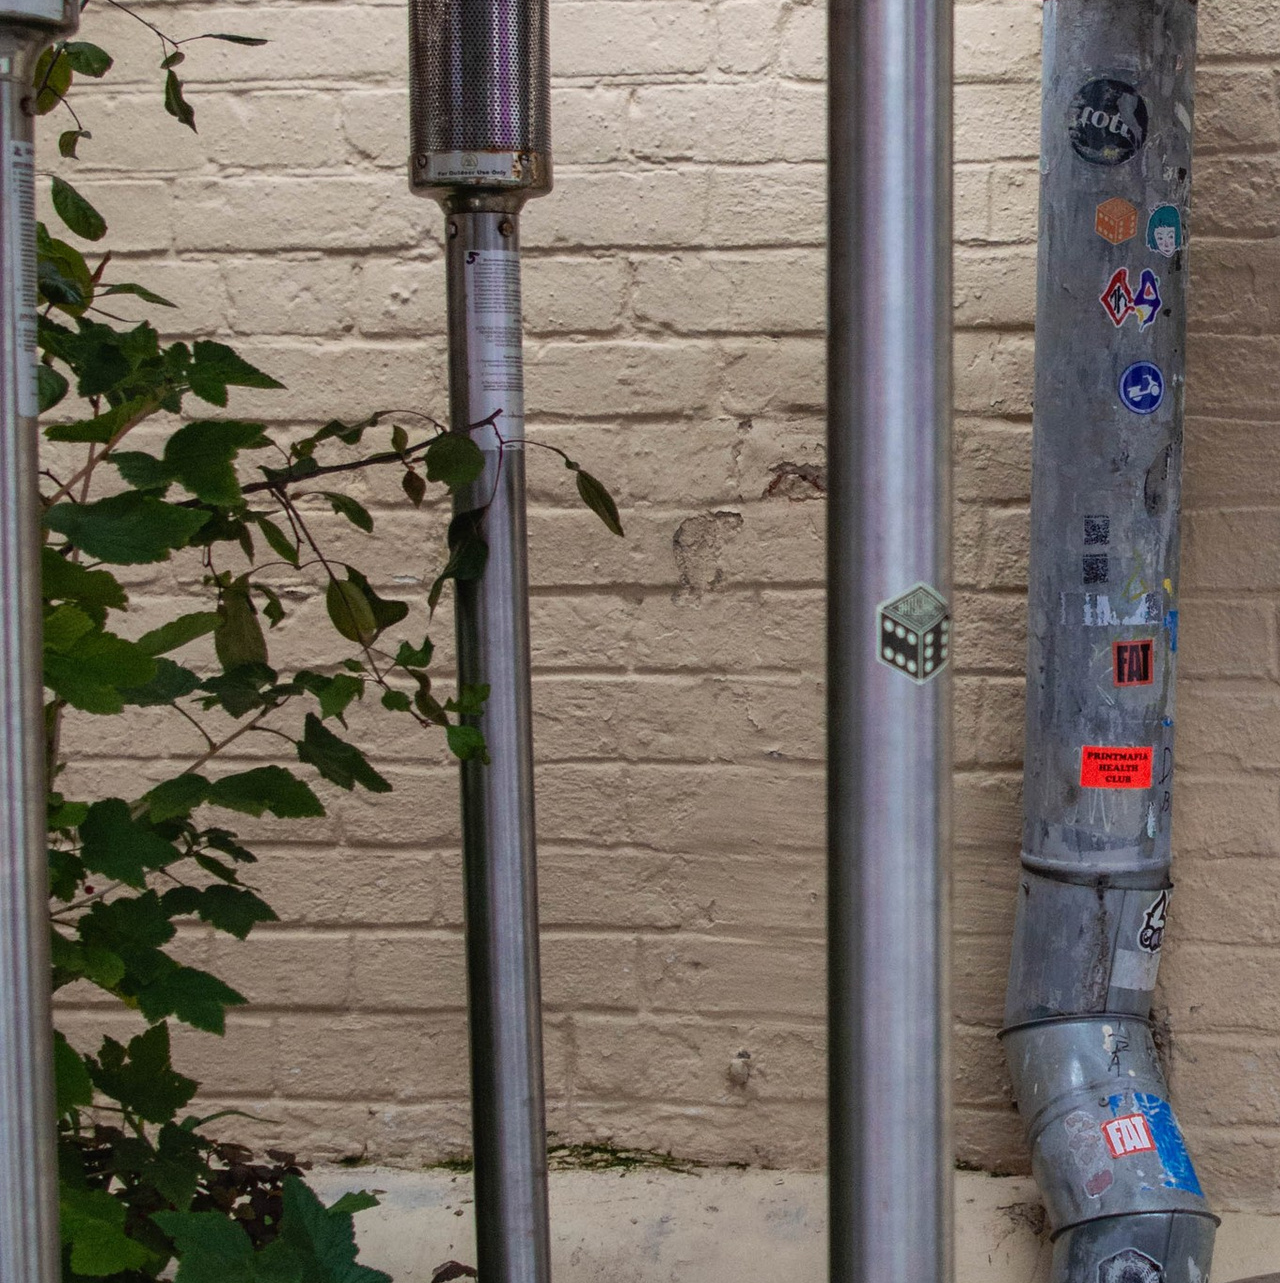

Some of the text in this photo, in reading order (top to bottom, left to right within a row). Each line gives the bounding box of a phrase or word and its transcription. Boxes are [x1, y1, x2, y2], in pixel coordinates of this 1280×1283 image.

[1117, 643, 1151, 683] FAT
[1087, 751, 1148, 761] PRINTMAFIA
[1098, 764, 1138, 772] HEALTH
[1105, 775, 1131, 783] CLUB
[1105, 1116, 1151, 1156] FAT
